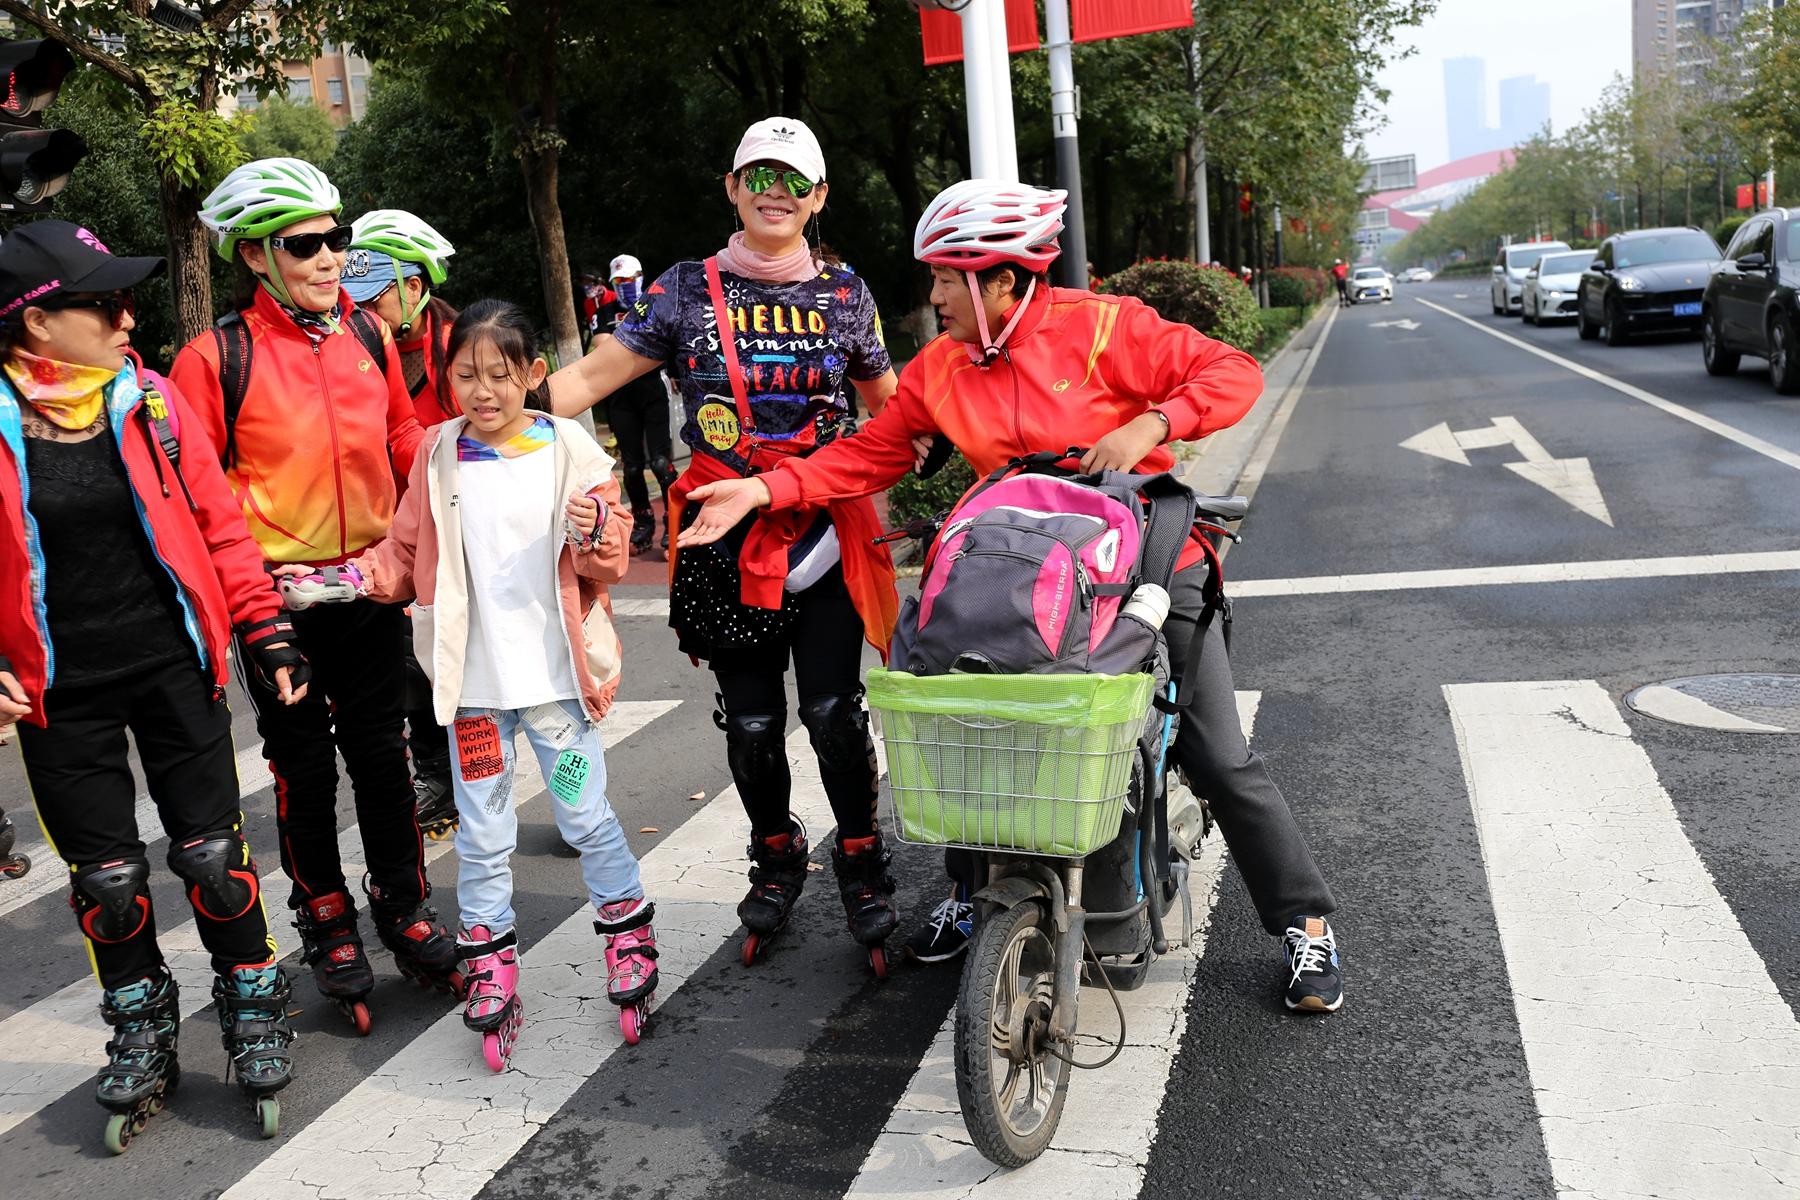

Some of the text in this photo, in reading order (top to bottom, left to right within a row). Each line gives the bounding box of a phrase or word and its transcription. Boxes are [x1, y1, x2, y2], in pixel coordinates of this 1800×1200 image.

[24, 280, 61, 300] EAGLE
[727, 304, 827, 335] HELLO
[1048, 561, 1068, 630] HIGH SIERRA
[456, 717, 493, 731] DON'T
[459, 729, 493, 743] WORK
[462, 741, 493, 756] WHIT
[469, 754, 492, 767] ASS
[565, 754, 588, 769] THE
[465, 766, 501, 780] HOLES
[559, 763, 586, 780] ONLY
